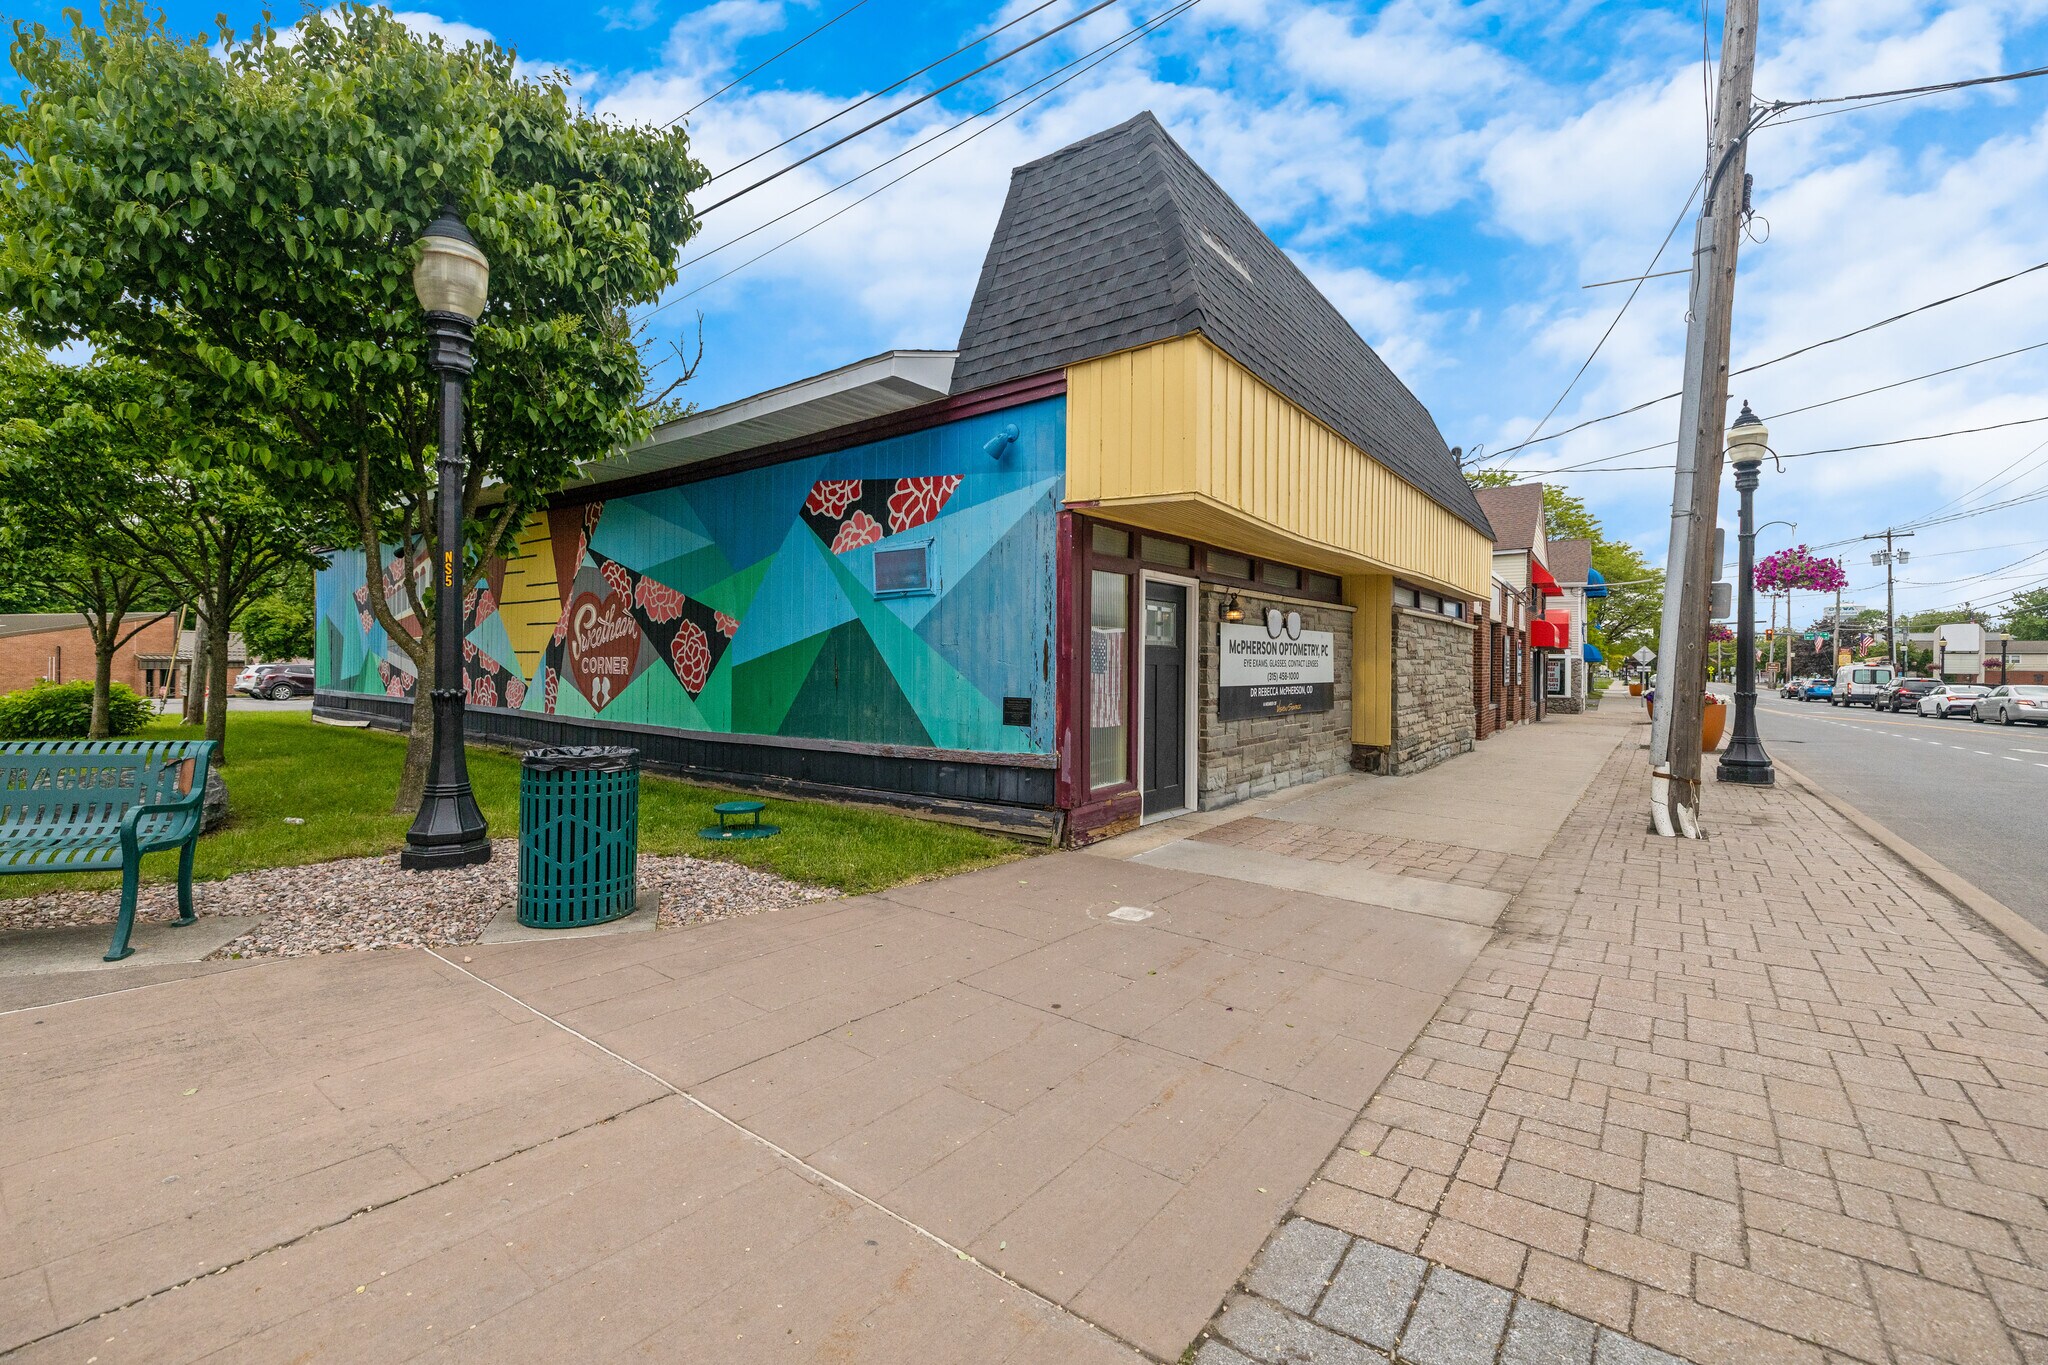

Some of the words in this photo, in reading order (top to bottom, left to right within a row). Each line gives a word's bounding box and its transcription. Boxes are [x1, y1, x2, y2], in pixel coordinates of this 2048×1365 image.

[572, 603, 638, 661] Sweetheart
[1229, 639, 1277, 655] McPHERSON
[1279, 642, 1320, 658] OPTOMETRY,
[1321, 644, 1329, 656] PC
[581, 656, 629, 675] CORNER
[1244, 659, 1252, 667] EYE
[1267, 672, 1278, 682] (315)
[1279, 672, 1299, 680] 458-1000
[1250, 687, 1257, 697] DR
[1258, 686, 1278, 697] REBECCA
[1306, 685, 1313, 694] OD
